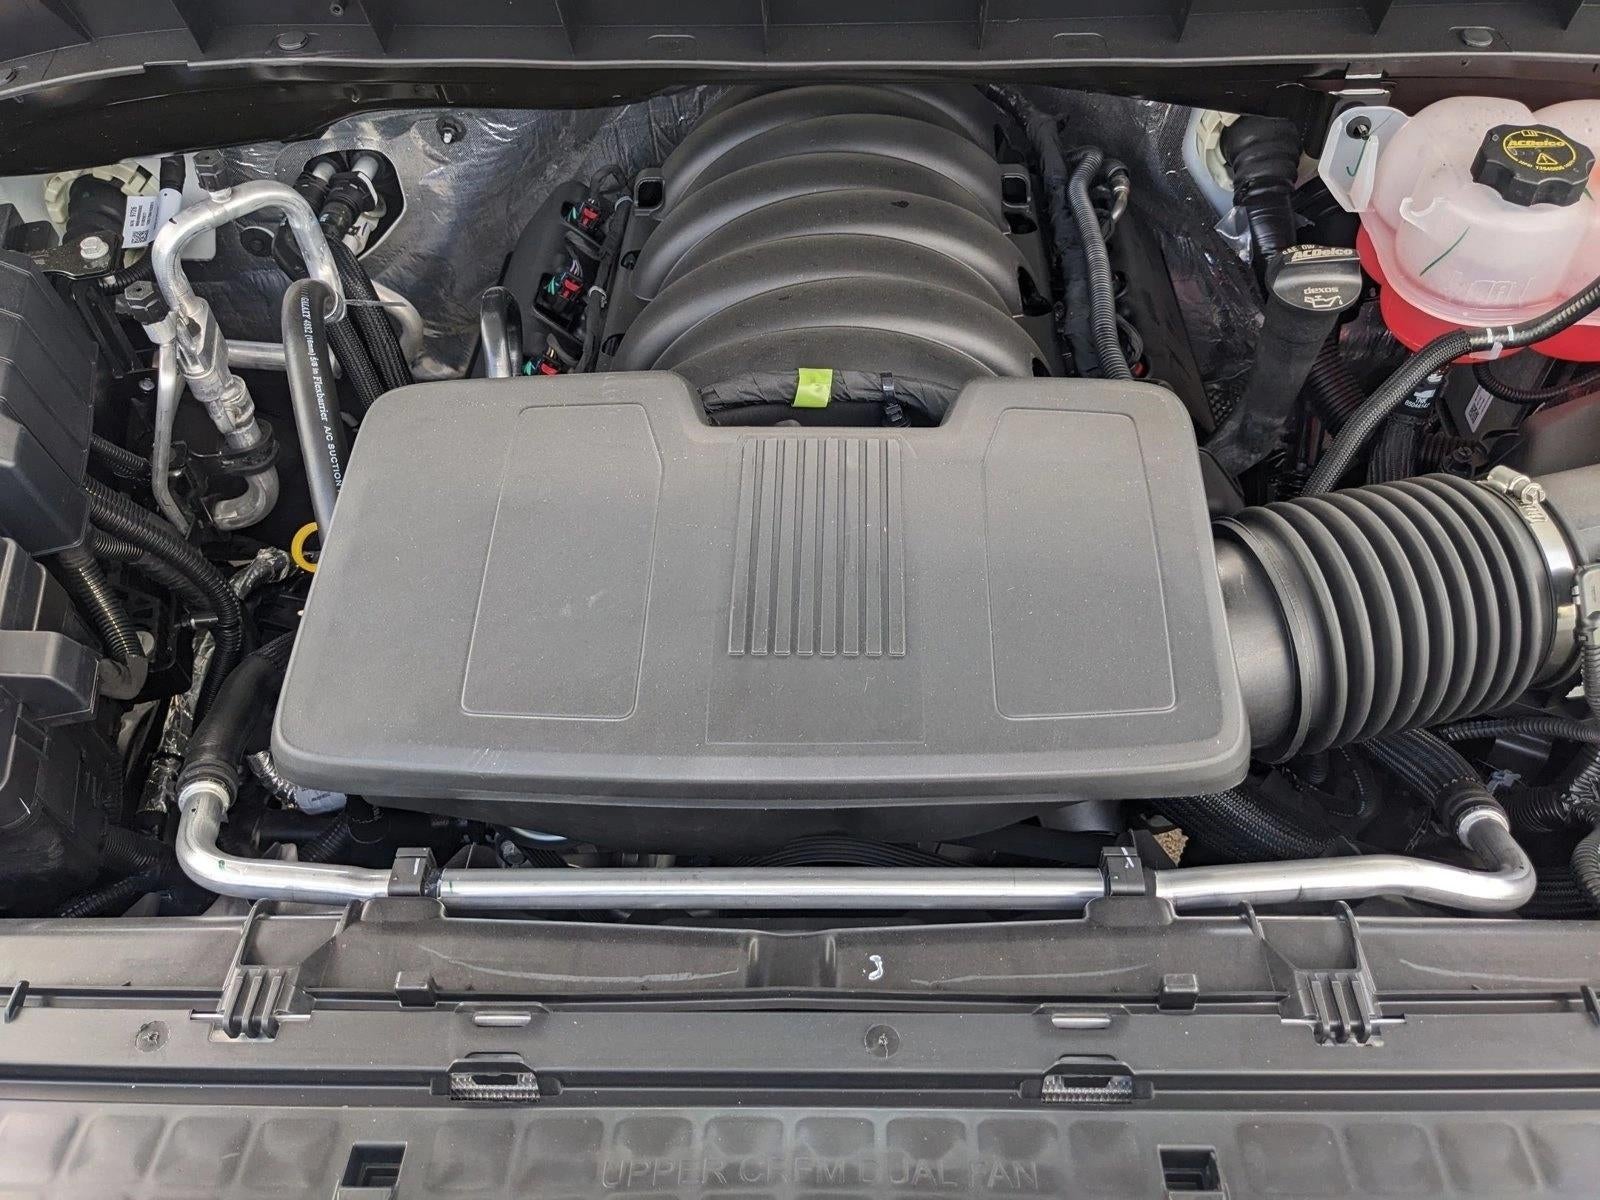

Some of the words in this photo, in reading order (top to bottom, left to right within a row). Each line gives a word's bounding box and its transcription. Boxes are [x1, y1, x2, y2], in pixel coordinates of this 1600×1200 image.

[1508, 139, 1566, 148] ACDelco
[1291, 247, 1353, 261] ACDelco
[1303, 286, 1339, 295] dexos
[300, 296, 311, 319] GALAXY
[313, 375, 329, 422] Flexbarrier
[323, 425, 334, 441] A/C
[327, 443, 342, 487] SUCTION
[601, 1158, 727, 1189] UPPER
[858, 1158, 958, 1186] DUAL
[968, 1159, 1039, 1190] FAN
